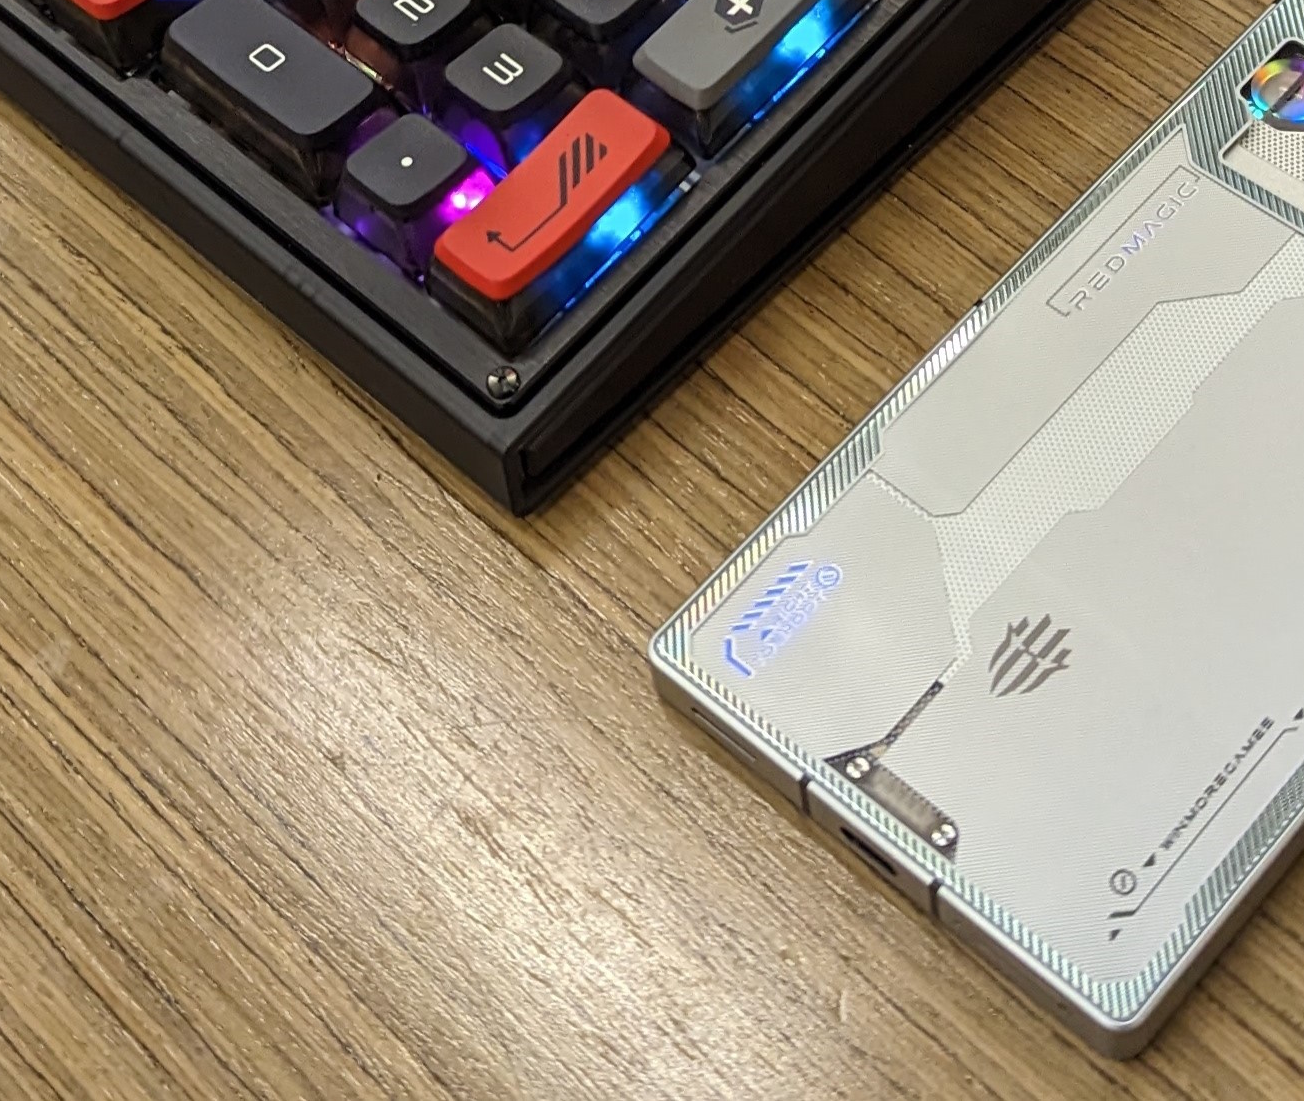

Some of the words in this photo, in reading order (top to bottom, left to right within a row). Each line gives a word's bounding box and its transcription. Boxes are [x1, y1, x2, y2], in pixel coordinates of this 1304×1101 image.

[248, 43, 286, 72] 0
[482, 52, 524, 85] 3
[1068, 181, 1198, 311] REDMAGIC
